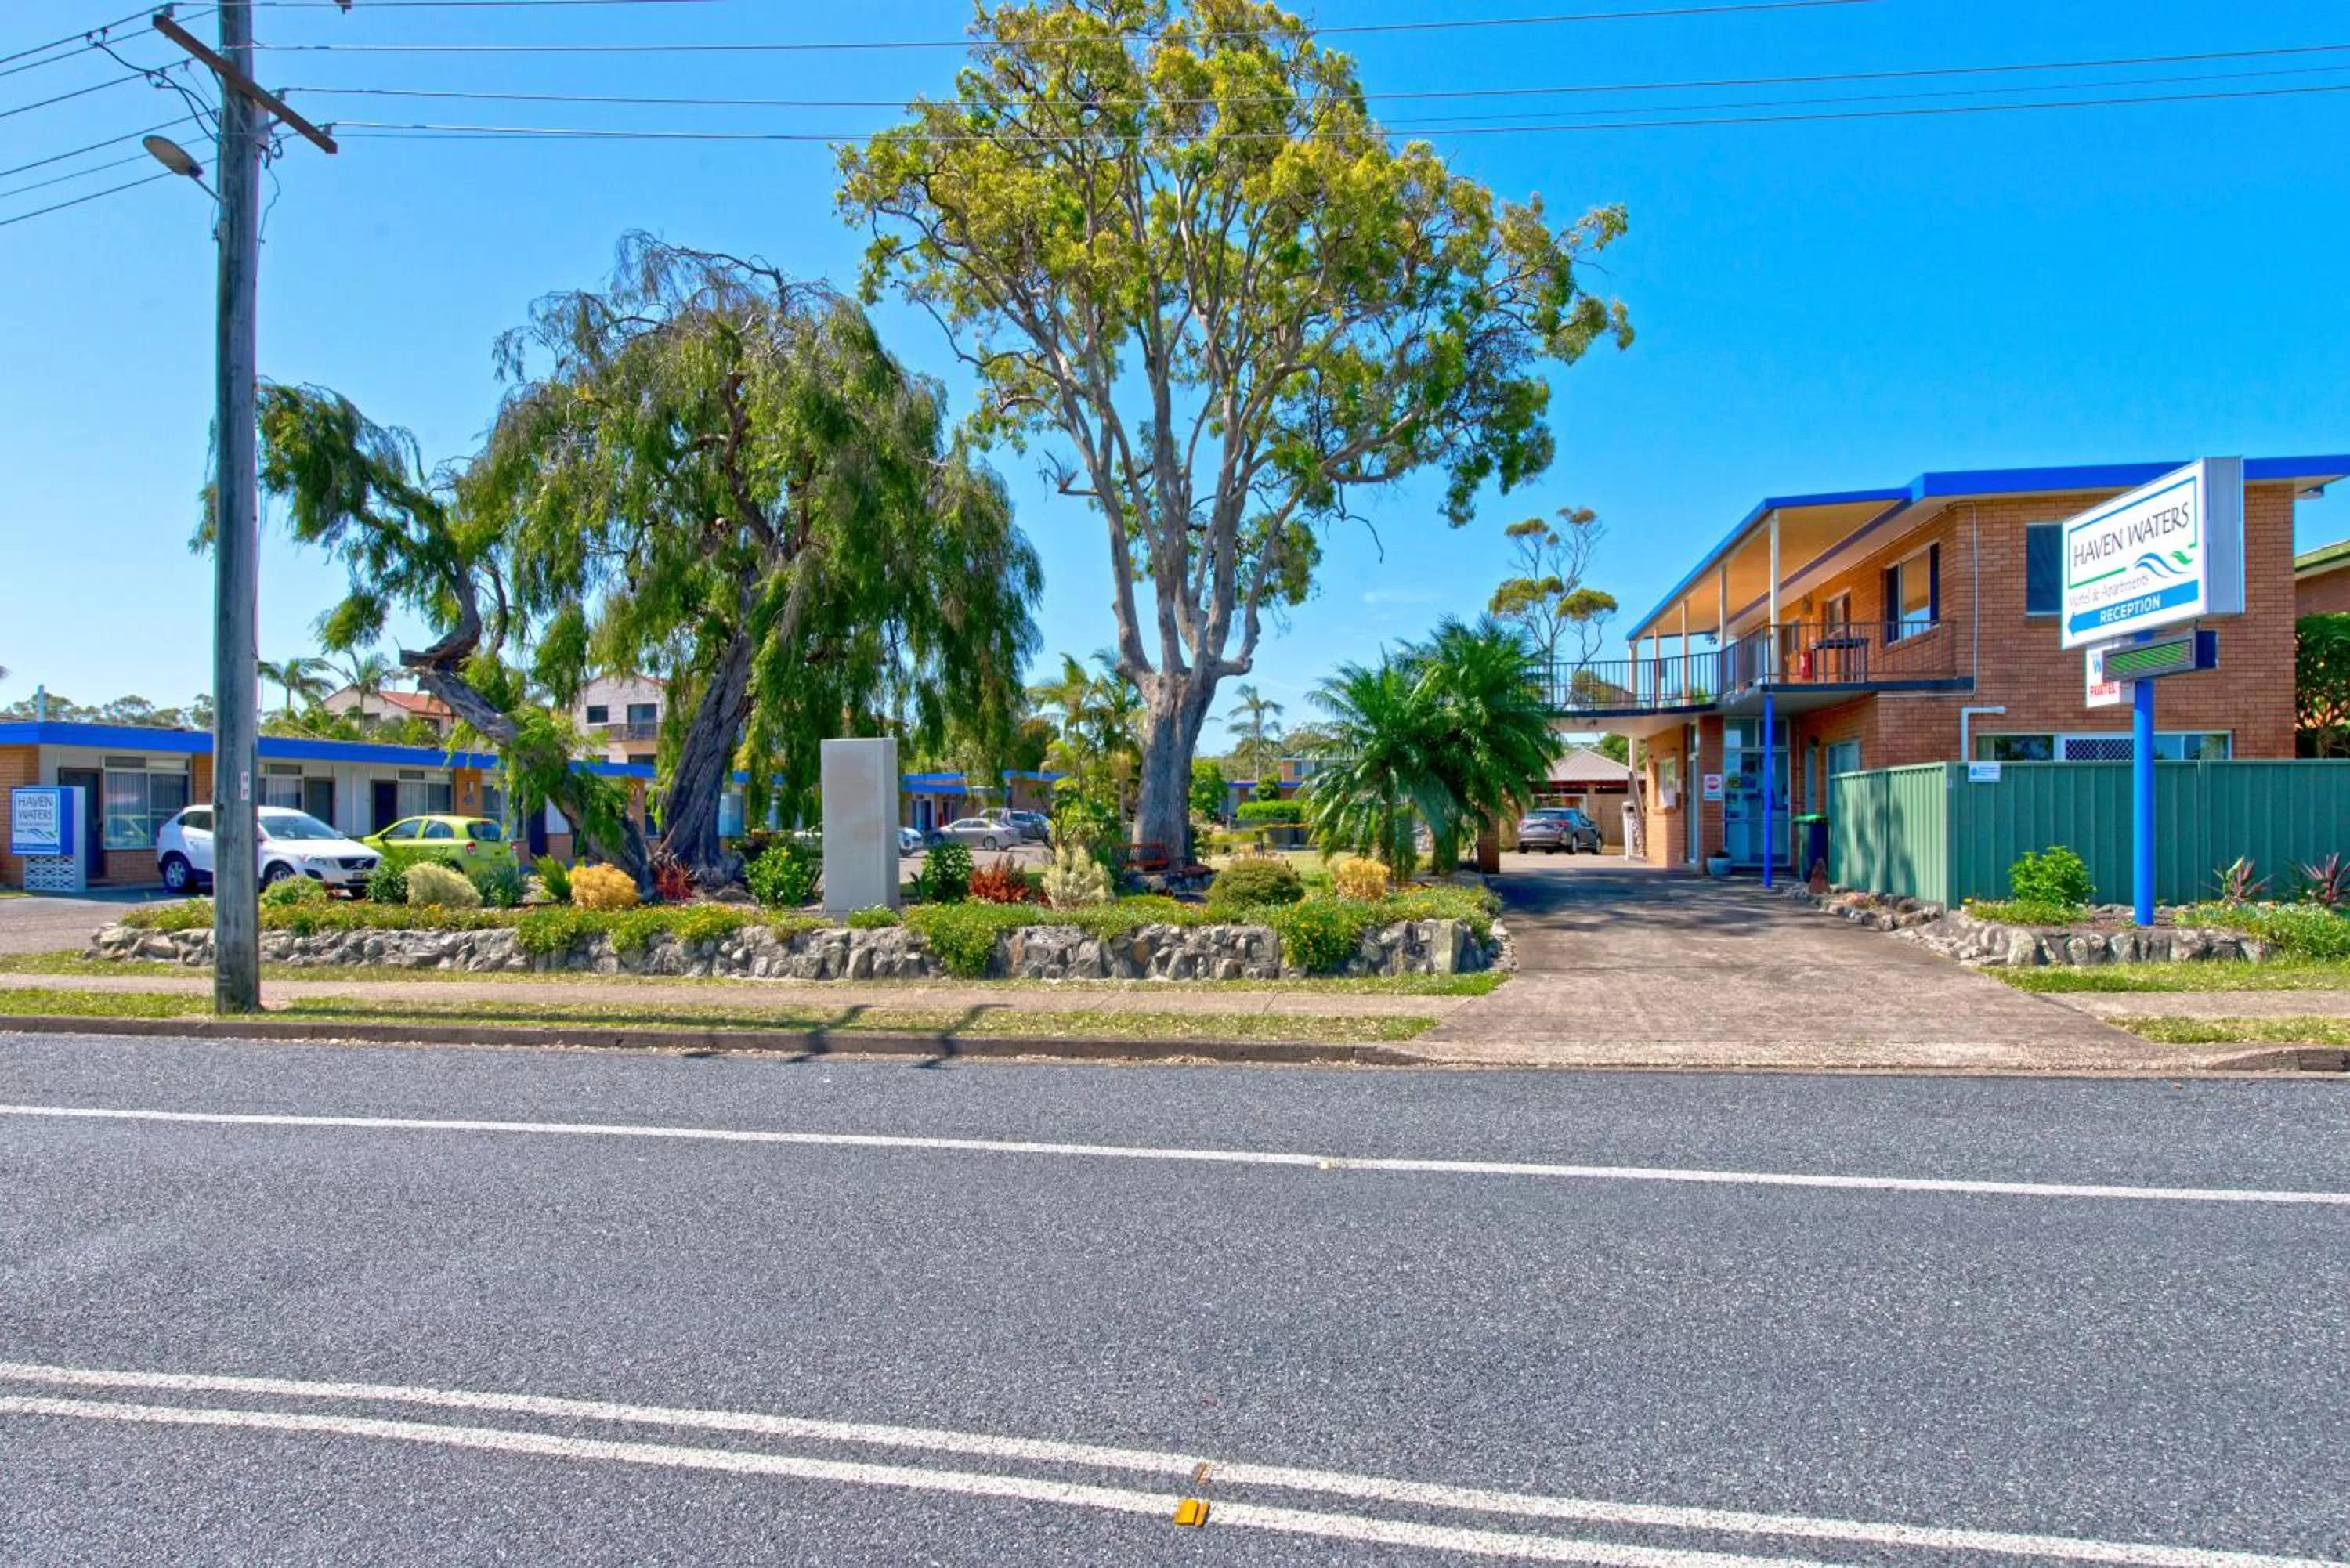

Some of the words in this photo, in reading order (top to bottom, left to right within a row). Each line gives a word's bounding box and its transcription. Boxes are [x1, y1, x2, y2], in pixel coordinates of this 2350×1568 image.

[2073, 528, 2123, 569] HAVEN
[2127, 501, 2189, 547] WATERS
[2099, 594, 2161, 624] RECEPTION
[18, 796, 53, 807] HAVEN
[18, 808, 53, 820] WATERS
